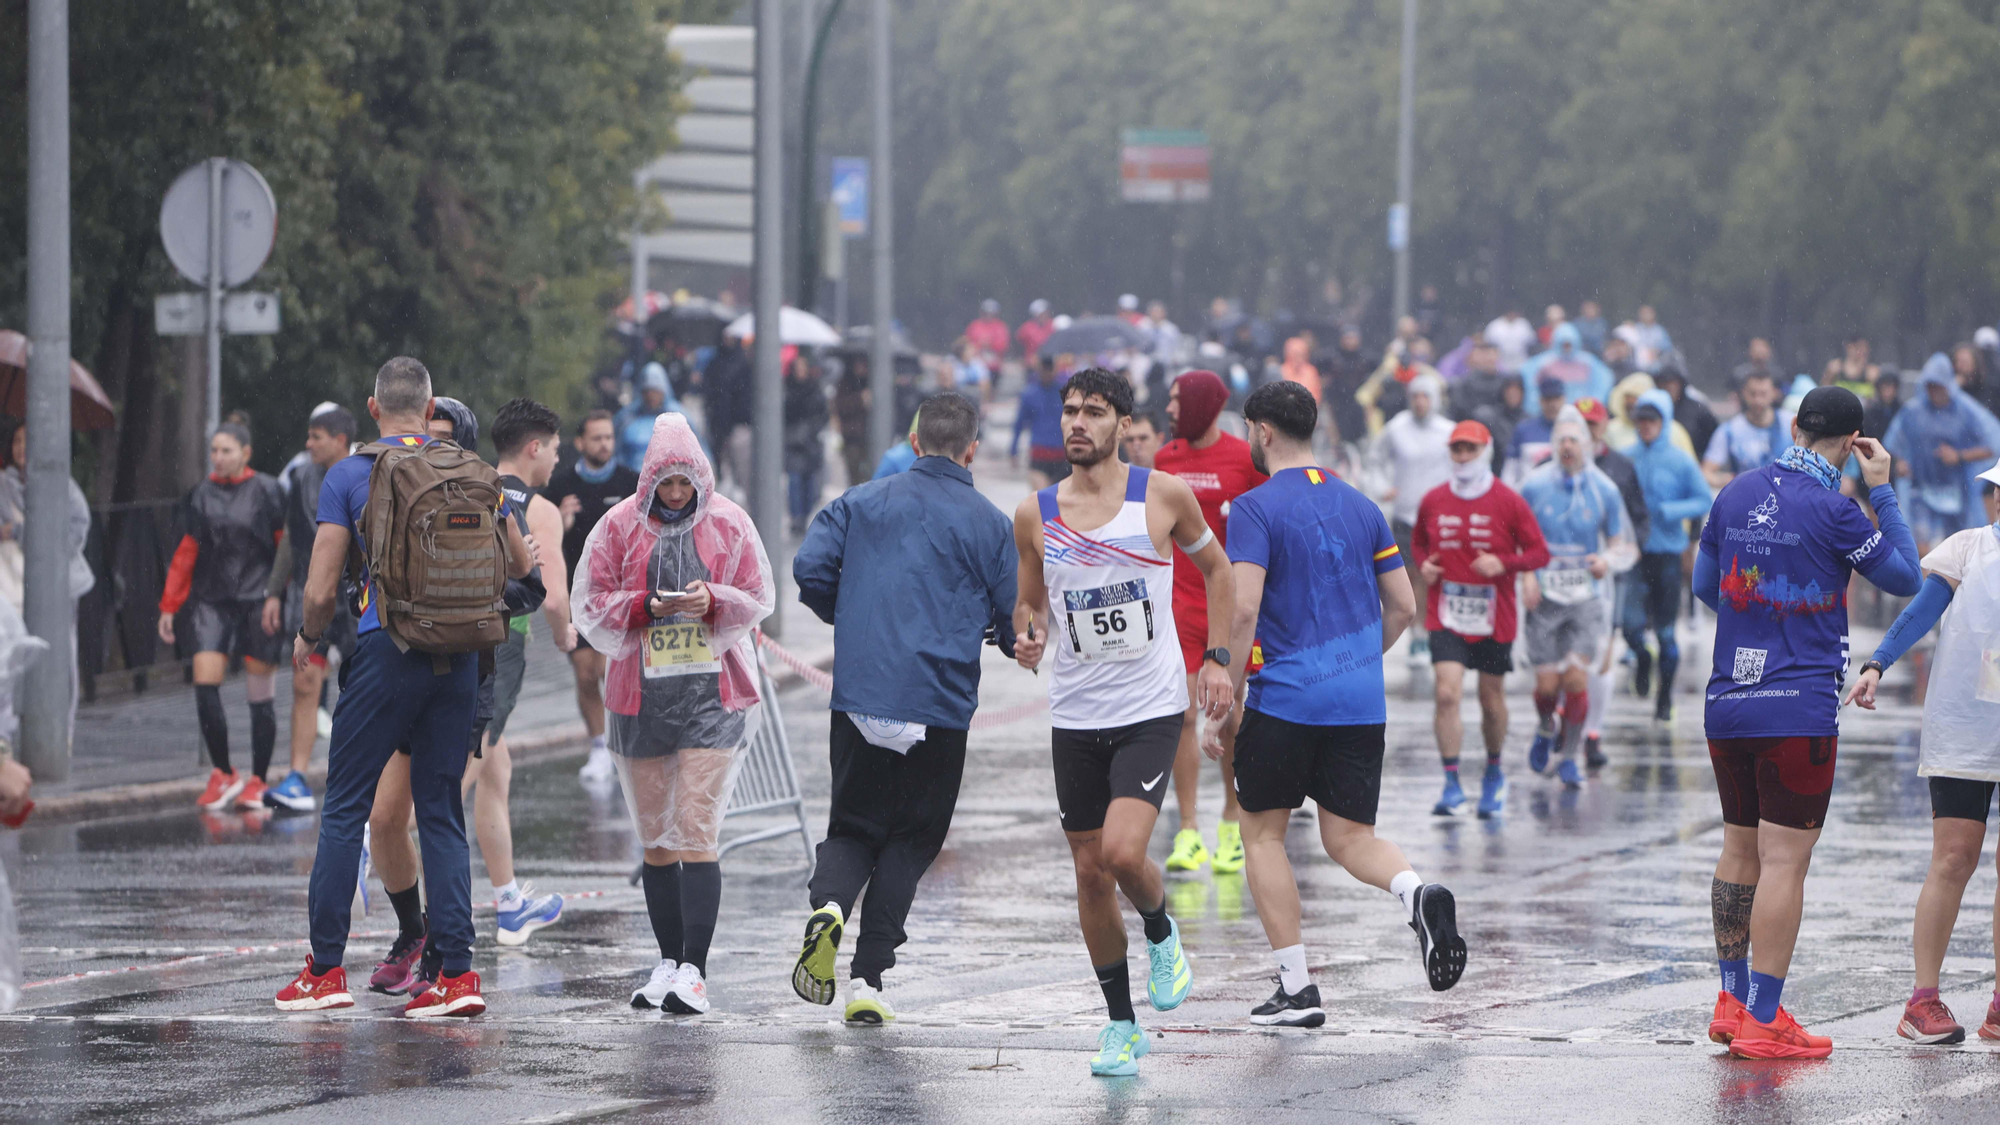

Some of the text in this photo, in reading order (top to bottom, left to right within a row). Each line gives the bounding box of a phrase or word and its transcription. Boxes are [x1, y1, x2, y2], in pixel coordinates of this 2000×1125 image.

[1725, 527, 1800, 546] TROTACALLES
[1746, 544, 1771, 555] CLUB
[1099, 582, 1129, 595] MEDIA
[1093, 609, 1127, 635] 56
[651, 627, 707, 651] 6275
[1102, 638, 1125, 646] MANUEL
[1335, 650, 1353, 665] BRI
[1344, 664, 1355, 673] EL
